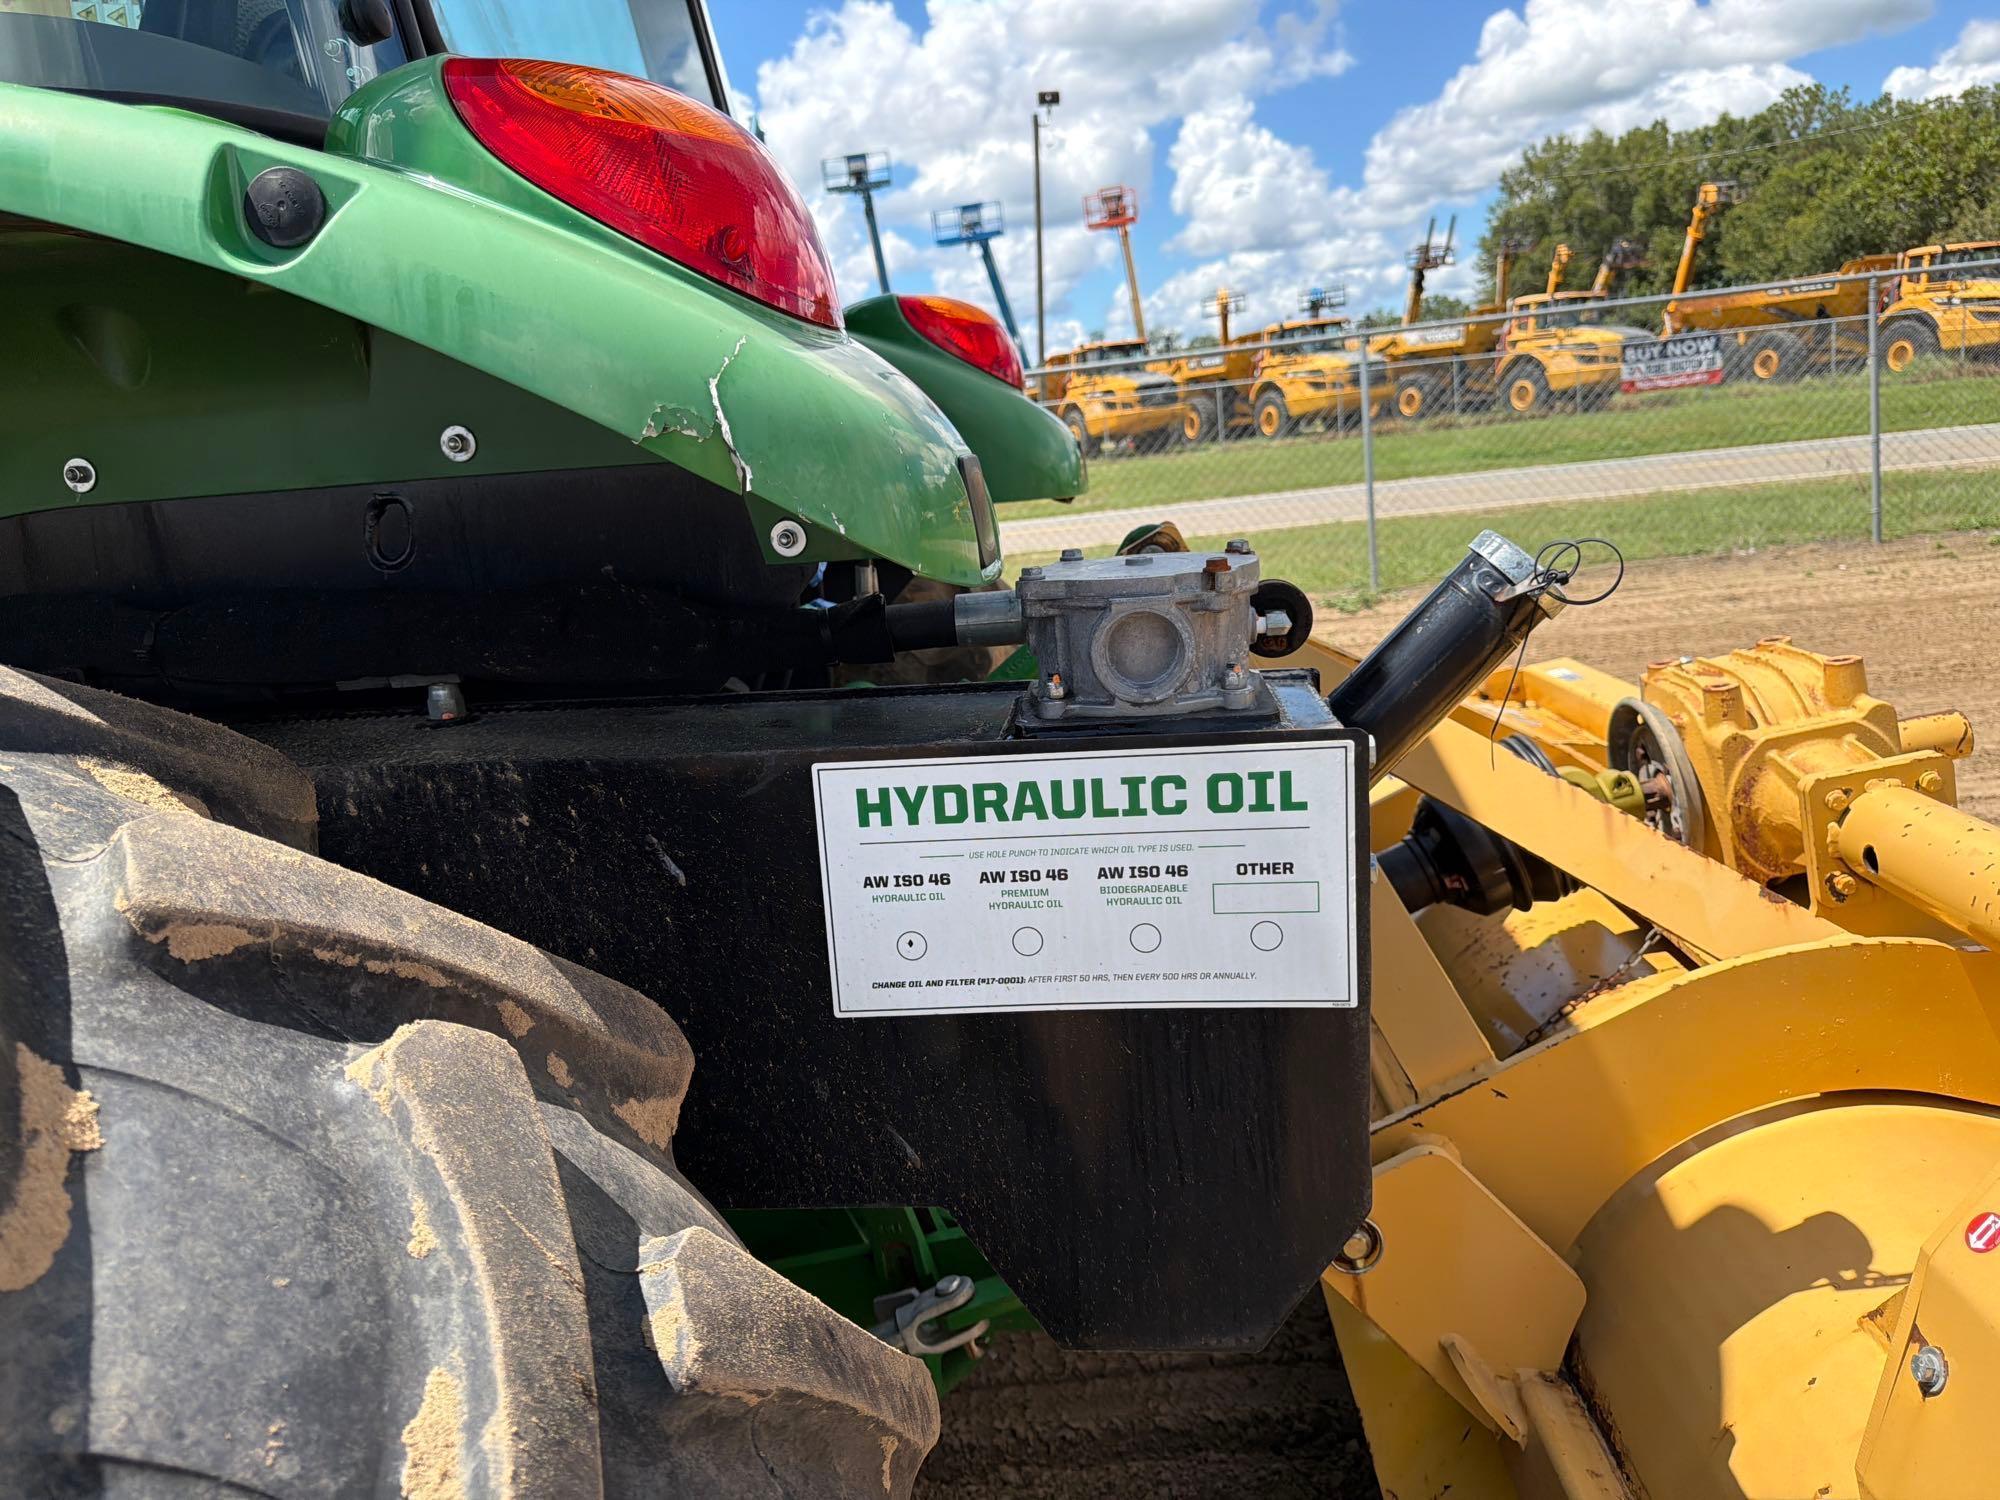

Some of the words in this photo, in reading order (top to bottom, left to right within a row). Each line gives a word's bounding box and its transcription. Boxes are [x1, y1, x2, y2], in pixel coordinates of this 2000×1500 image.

[1667, 337, 1717, 356] NOW
[856, 775, 1187, 827] HYDRAULIC
[1207, 771, 1308, 813] OIL
[969, 850, 984, 860] USE
[987, 850, 1006, 859] HOLE
[1009, 848, 1036, 858] PUNCH
[1038, 848, 1048, 857] TO
[1051, 846, 1089, 857] INDICATE
[1091, 845, 1119, 855] WHICH
[1121, 845, 1135, 854] OIL
[1137, 843, 1156, 853] TYPE
[1158, 843, 1168, 853] IS
[1170, 843, 1194, 852] USED.
[980, 870, 1005, 885] AW
[1010, 869, 1041, 883] ISO
[1046, 868, 1068, 882] 46
[1098, 866, 1124, 880] AW
[1129, 865, 1160, 879] ISO
[1165, 864, 1188, 878] 46
[1237, 861, 1294, 876] OTHER
[864, 875, 888, 889] AW
[893, 873, 924, 888] ISO
[929, 872, 950, 886] 46
[1001, 887, 1050, 899] PREMIUM
[1100, 883, 1188, 896] BIODEGRADEABLE
[872, 892, 926, 904] HYDRAULIC
[929, 892, 945, 901] OIL
[989, 899, 1043, 911] HYDRAULIC
[1047, 899, 1063, 909] OIL
[1107, 896, 1162, 907] HYDRAULIC
[1165, 896, 1182, 905] OIL
[872, 980, 906, 990] CHANGE
[909, 980, 923, 988] OIL
[925, 979, 943, 988] AND
[945, 978, 975, 987] FILTER
[1028, 975, 1052, 984] AFTER
[1054, 974, 1077, 983] FIRST
[1079, 974, 1090, 983] 50
[1092, 973, 1110, 983] HRS,
[1113, 973, 1133, 982] THEN
[1136, 972, 1160, 981] EVERY
[1162, 972, 1179, 981] 500
[1181, 972, 1198, 981] HRS
[1200, 971, 1211, 981] OR
[1213, 971, 1256, 980] ANNUALLY.
